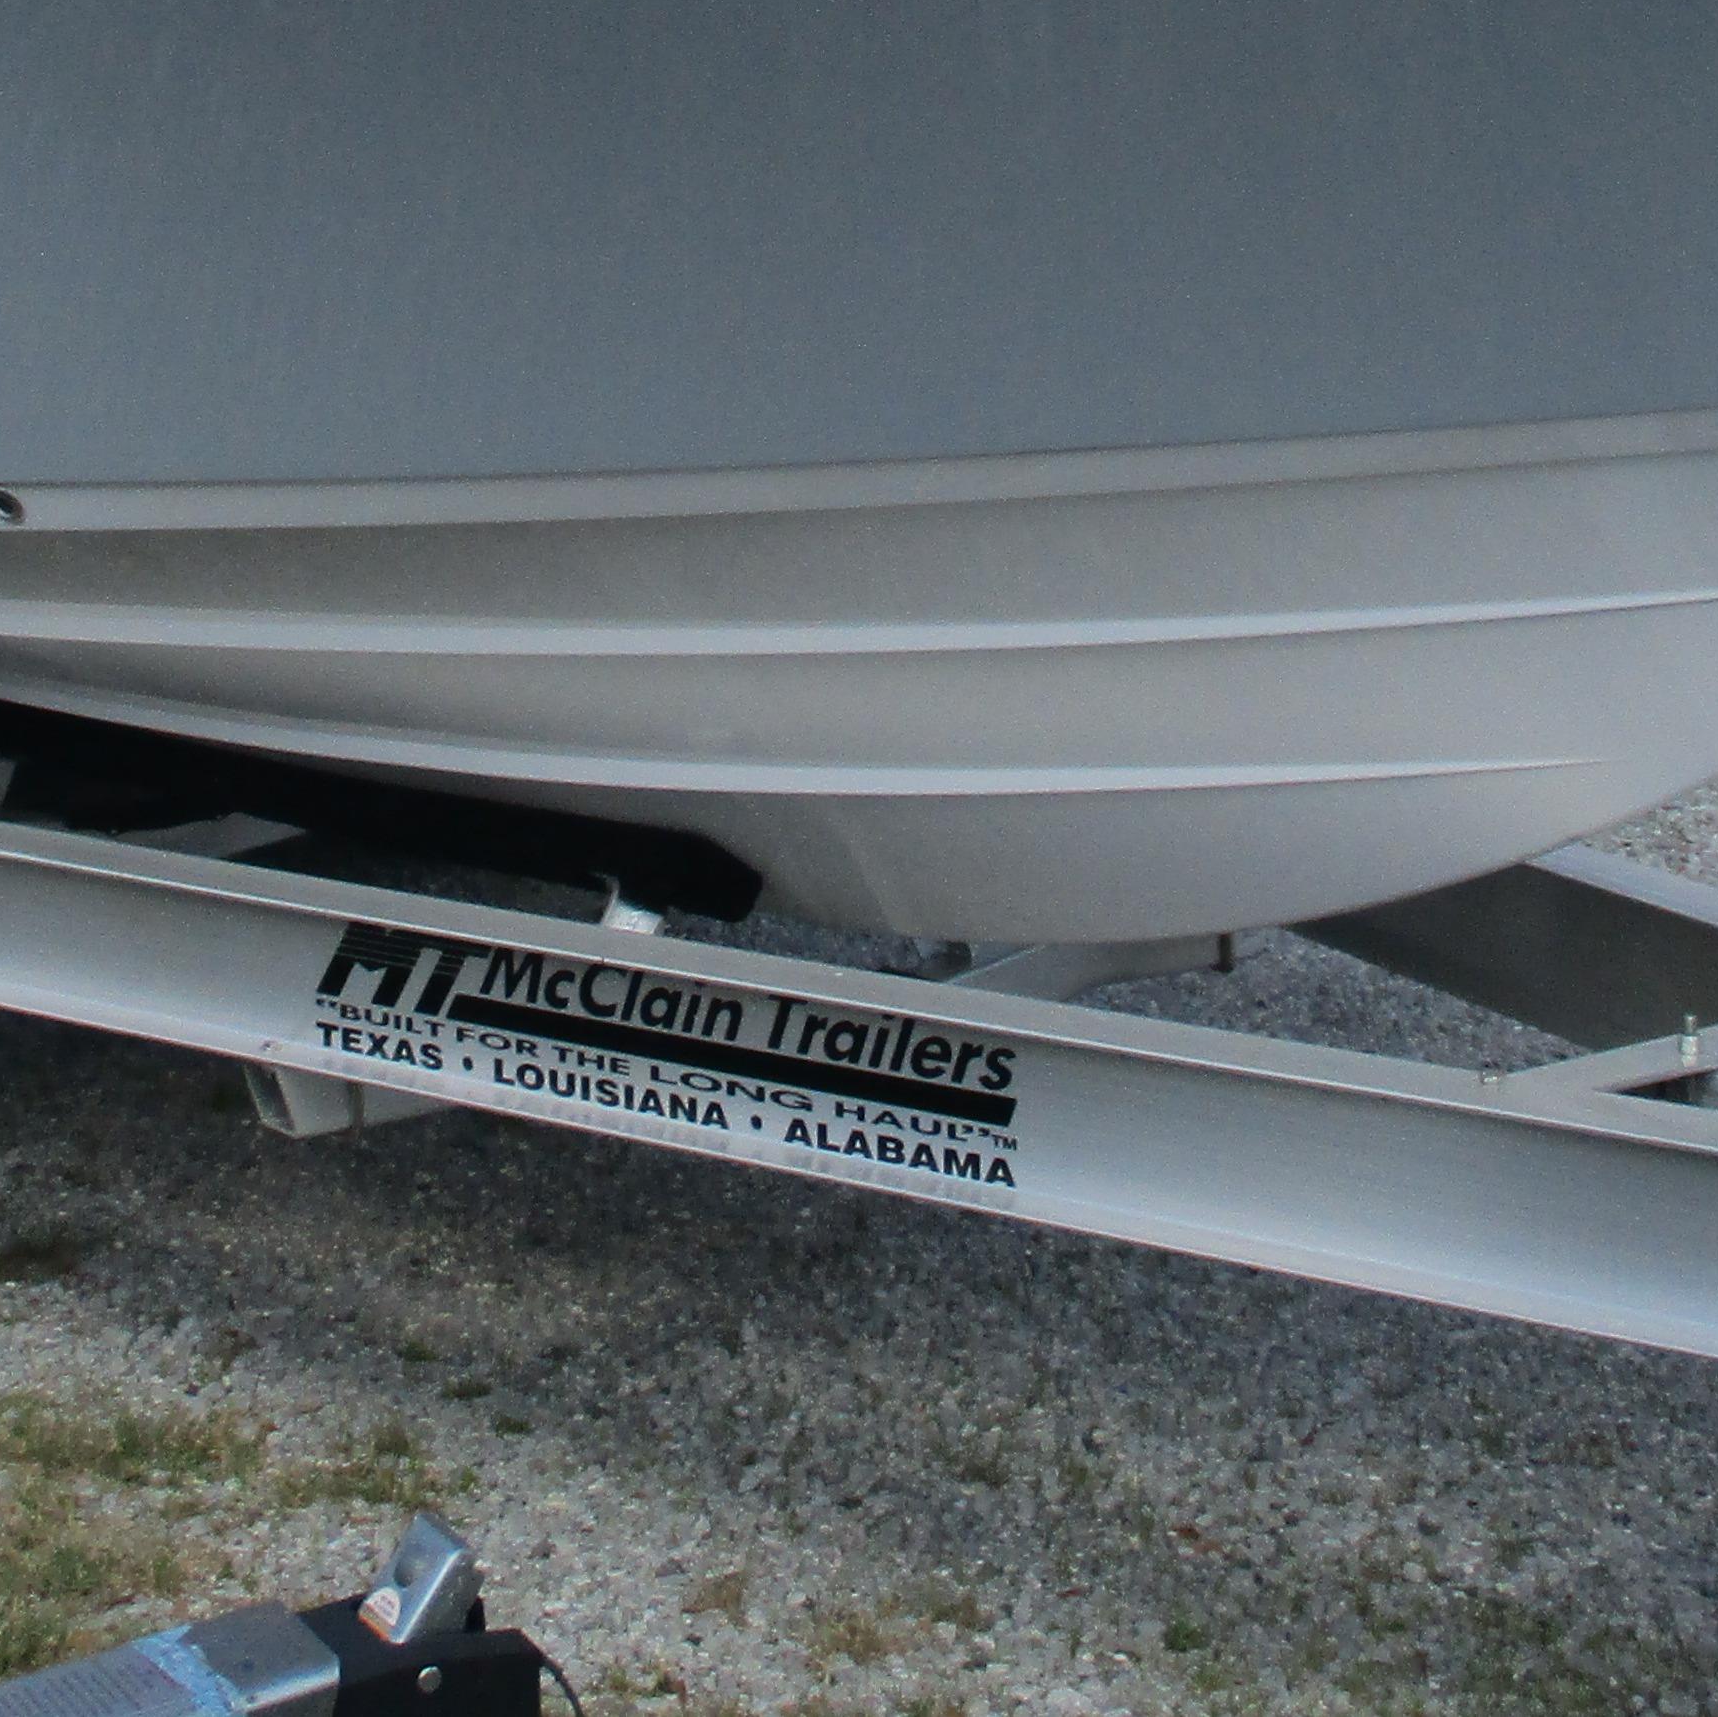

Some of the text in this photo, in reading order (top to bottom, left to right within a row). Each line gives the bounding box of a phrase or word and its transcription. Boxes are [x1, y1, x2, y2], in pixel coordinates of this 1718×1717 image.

[455, 1026, 538, 1058] FOR
[551, 1045, 631, 1077] THE
[650, 1064, 814, 1112] LONG
[481, 947, 1017, 1091] McClain Trailers
[316, 1021, 1017, 1188] TEXAS LOUISIANA ALABAMA
